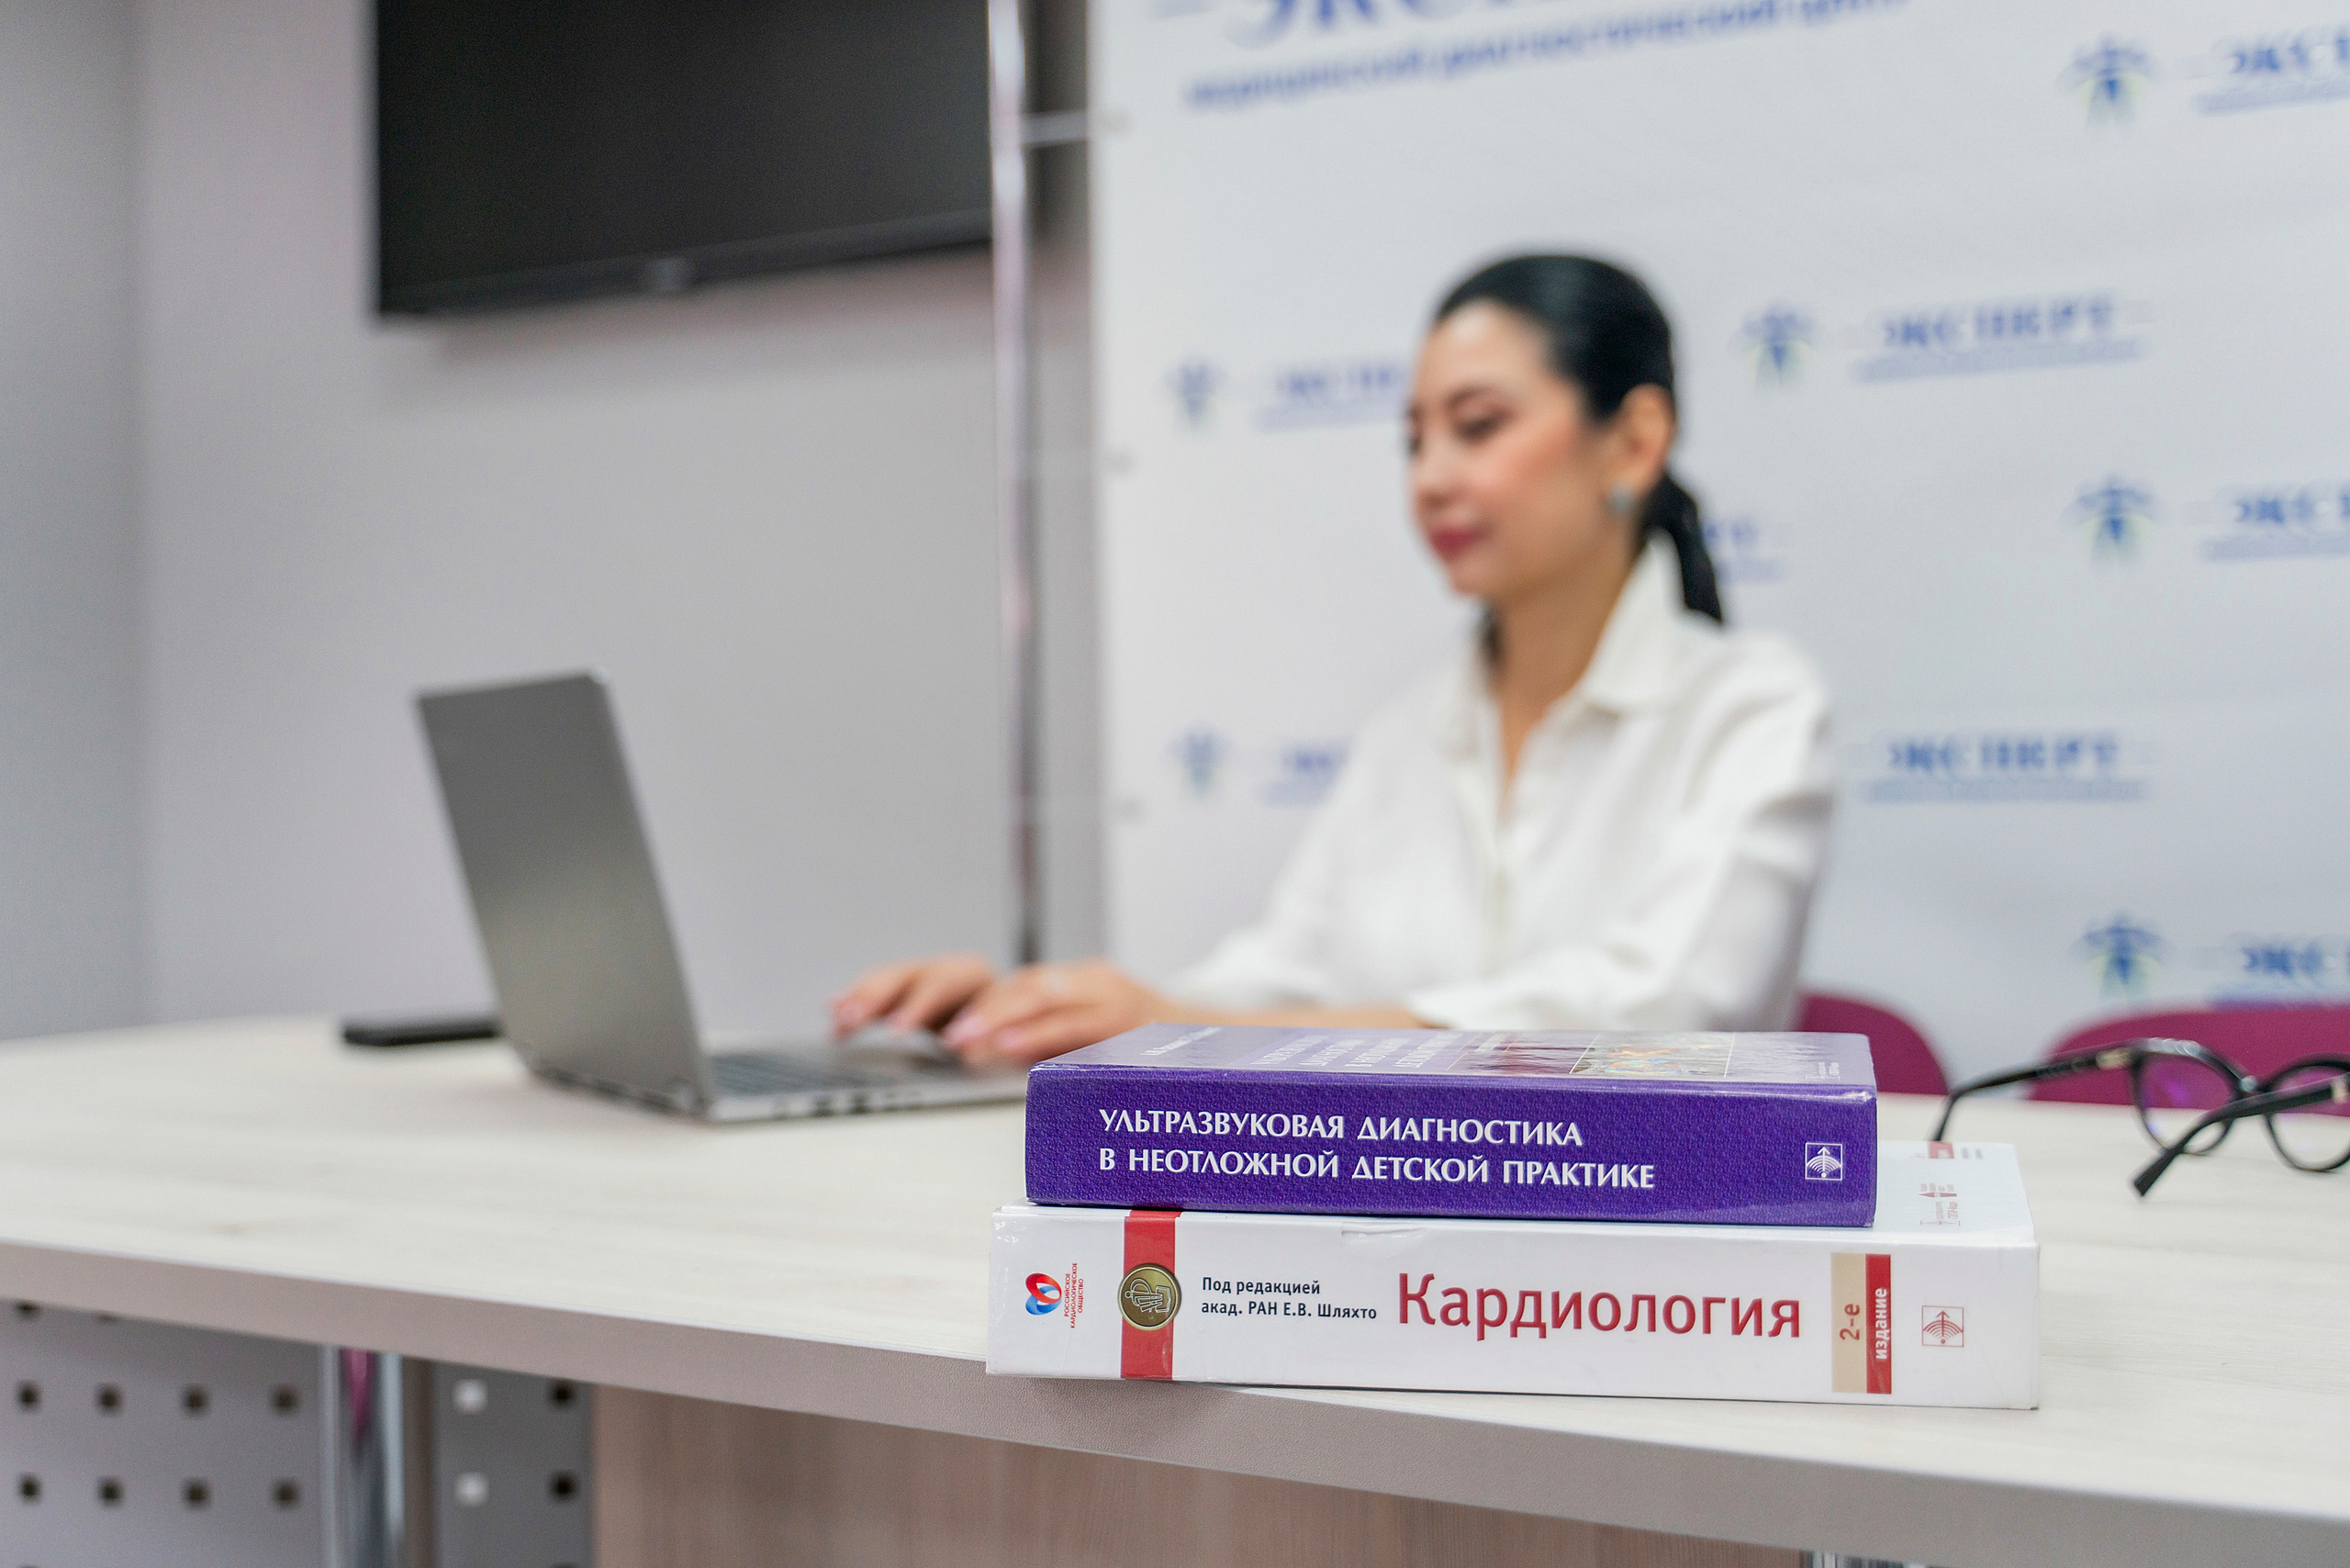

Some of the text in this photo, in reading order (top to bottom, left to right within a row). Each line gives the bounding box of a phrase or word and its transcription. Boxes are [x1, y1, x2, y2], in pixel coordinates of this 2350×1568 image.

[1099, 1109, 1583, 1147] УЛЬТРАЗВУКОВАЯ ДИАГНОСТИКА
[1099, 1148, 1655, 1189] В НЕОТЛОЖНОЙ ДЕТСКОЙ ПРАКТИКЕ
[1063, 1272, 1071, 1317] РОССИЙСКОЕ
[1069, 1261, 1078, 1328] КАРДИОЛОГИЧЕСКОЕ
[1203, 1277, 1320, 1295] Под редакцией
[1399, 1272, 1800, 1341] Кардиология
[1202, 1301, 1377, 1319] акад. РАН Е.В. Шляхто
[1839, 1303, 1861, 1341] 2-е
[1874, 1287, 1889, 1360] издание
